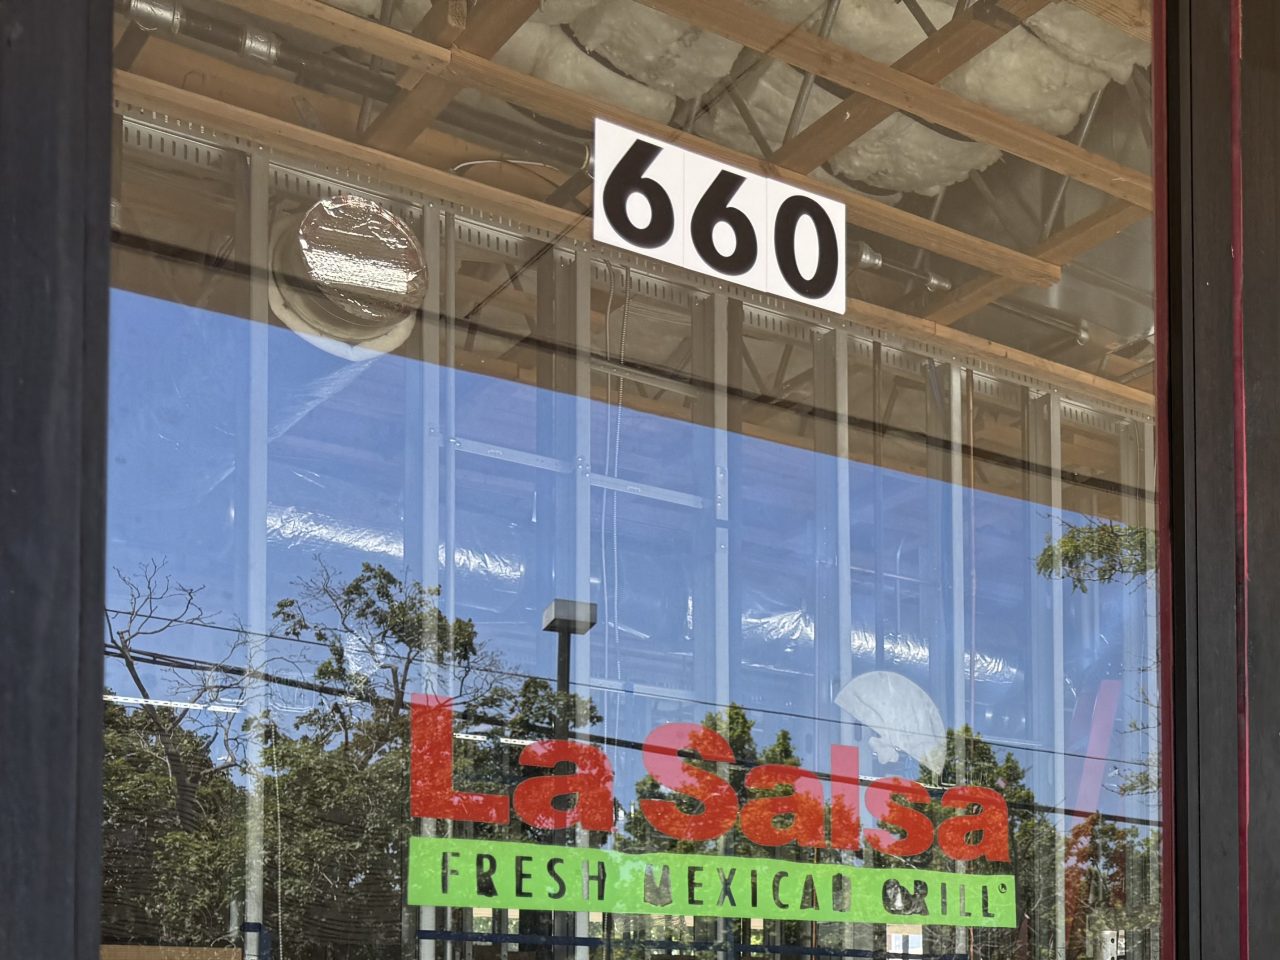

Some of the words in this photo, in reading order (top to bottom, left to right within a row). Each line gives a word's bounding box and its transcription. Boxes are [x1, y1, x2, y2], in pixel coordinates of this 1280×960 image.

[603, 139, 838, 299] 660
[410, 693, 616, 832] La
[641, 722, 1010, 862] Salsa
[441, 851, 607, 901] FRESH
[643, 863, 852, 914] MEXICAN
